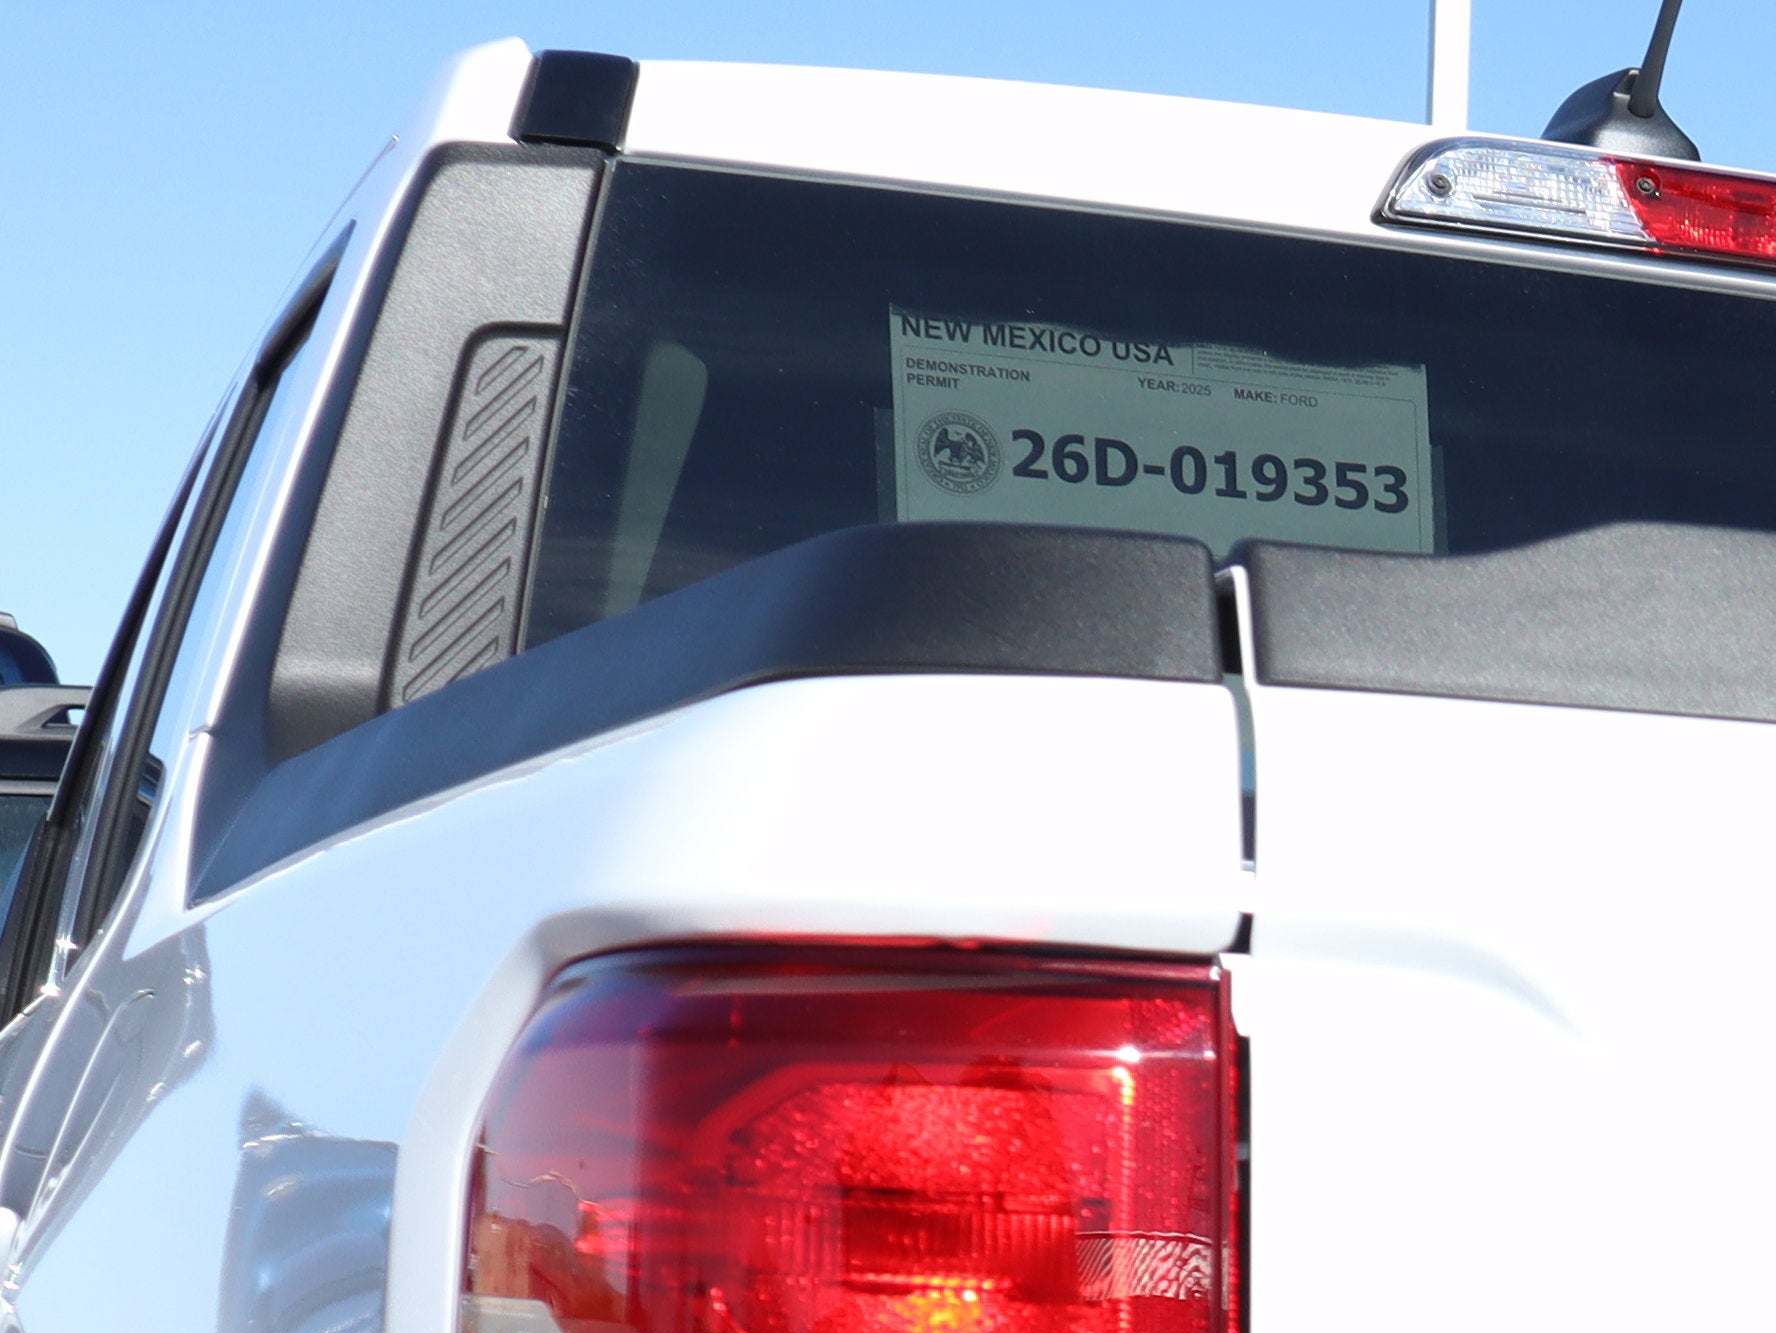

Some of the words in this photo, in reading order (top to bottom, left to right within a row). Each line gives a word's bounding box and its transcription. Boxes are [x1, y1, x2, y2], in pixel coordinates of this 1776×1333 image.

[901, 315, 972, 343] NEW
[982, 323, 1101, 358] MEXICO
[1110, 341, 1175, 367] USA
[905, 357, 1031, 382] DEMONSTRATION
[906, 373, 960, 390] PERMIT
[1137, 377, 1180, 393] YEAR:
[1181, 382, 1212, 397] 2025
[1233, 388, 1278, 404] MAKE:
[1280, 392, 1319, 408] FORD
[1011, 428, 1410, 515] 26D-019353
